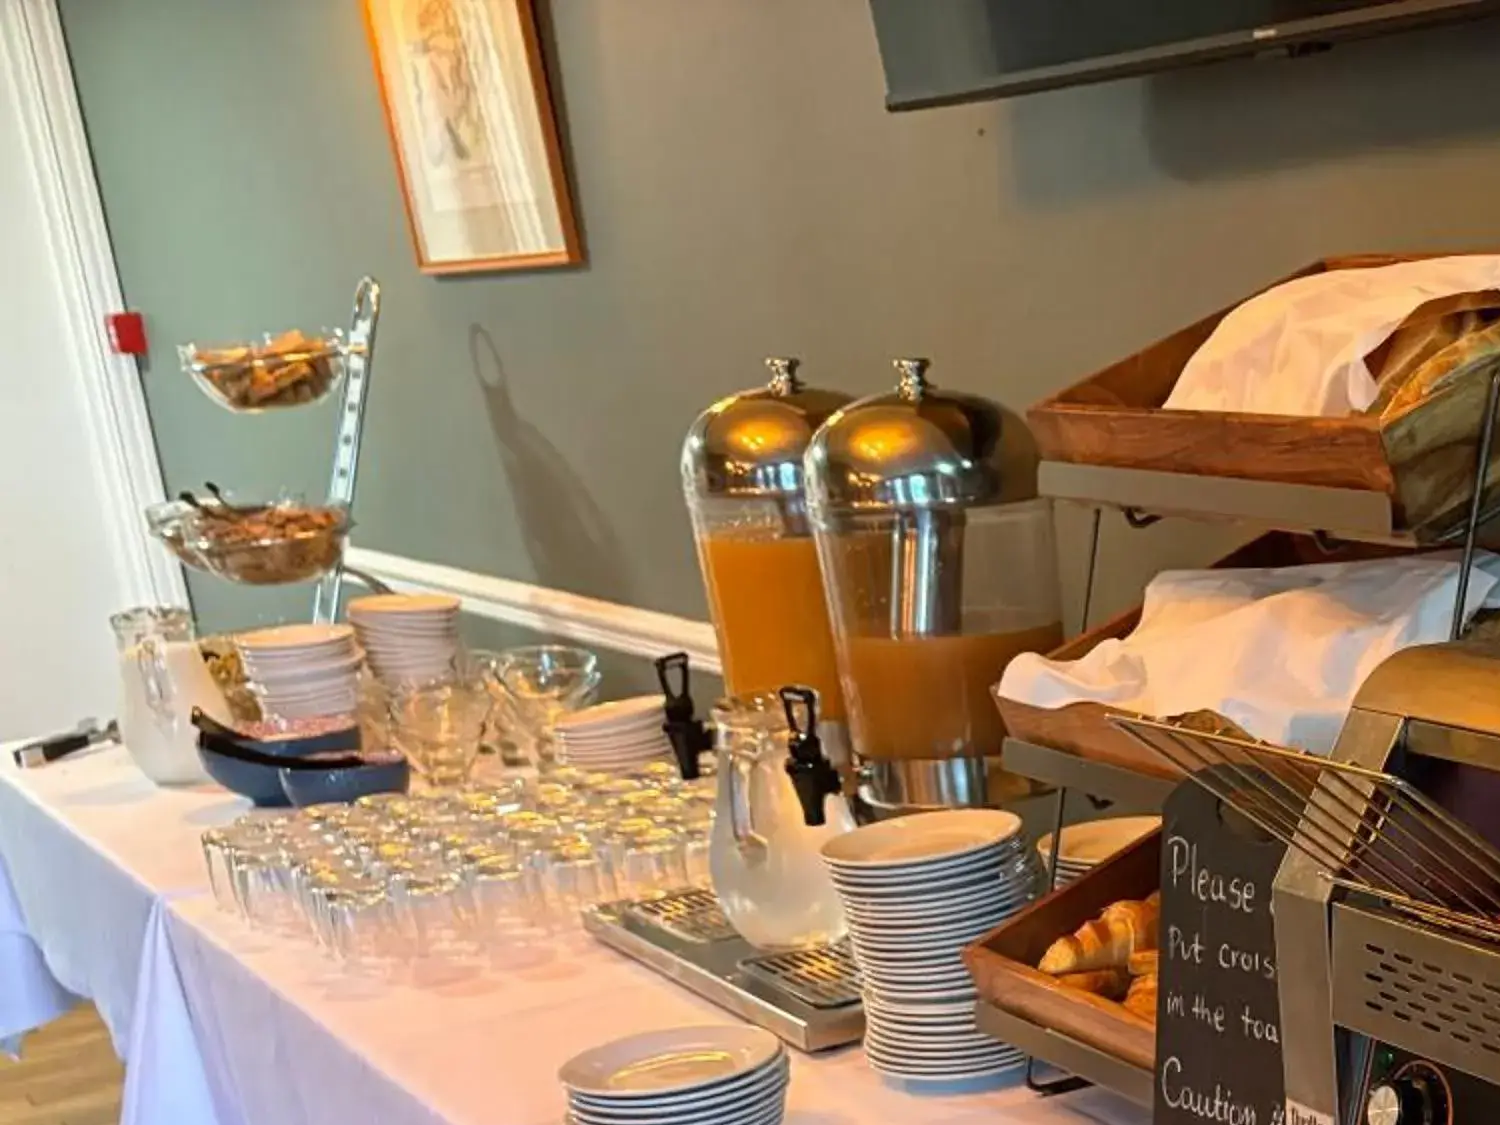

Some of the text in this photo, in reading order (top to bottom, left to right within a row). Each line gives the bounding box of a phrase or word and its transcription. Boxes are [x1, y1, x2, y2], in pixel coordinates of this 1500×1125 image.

[1167, 834, 1256, 914] Please
[1168, 924, 1277, 979] Put crois
[1191, 993, 1225, 1033] the
[1241, 1004, 1279, 1044] toa
